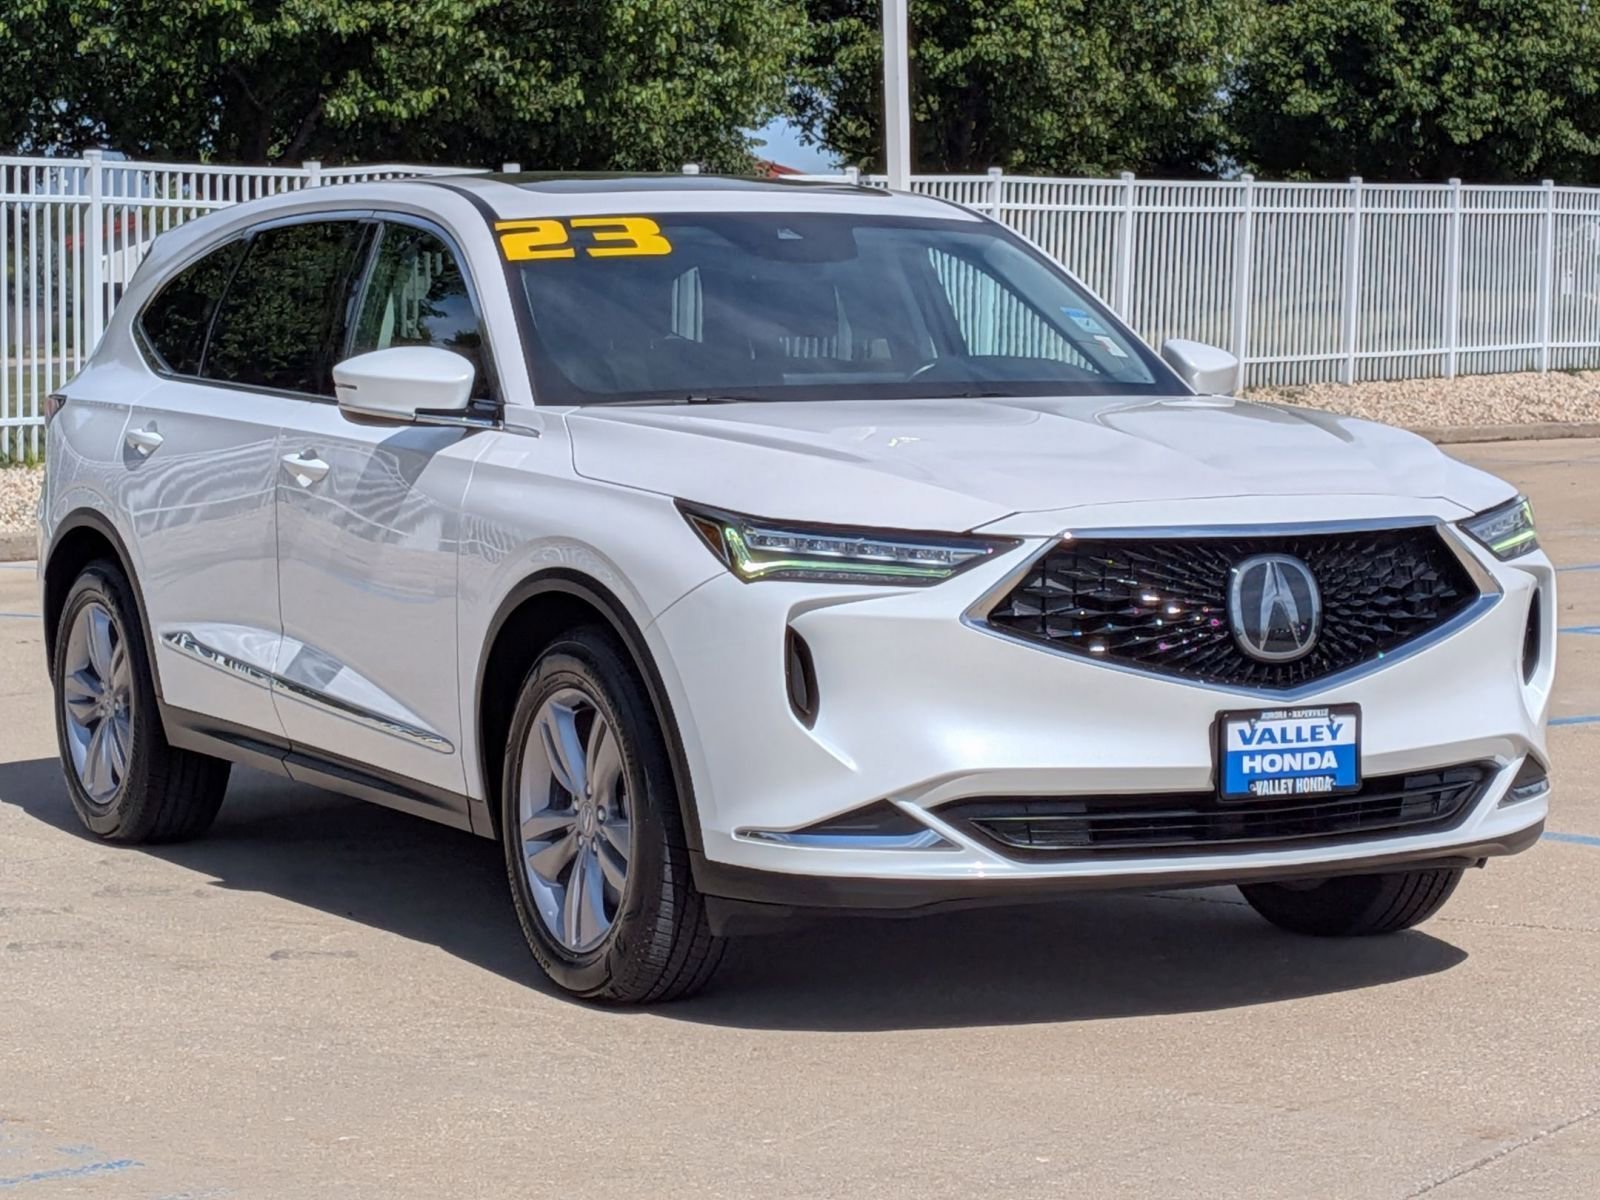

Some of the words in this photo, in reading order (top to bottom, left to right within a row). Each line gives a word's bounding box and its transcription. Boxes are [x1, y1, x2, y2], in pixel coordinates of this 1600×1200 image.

[495, 217, 672, 261] 23
[1238, 723, 1343, 746] VALLEY
[1242, 751, 1338, 774] HONDA
[1255, 778, 1294, 796] VALLEY
[1296, 776, 1332, 794] HONDA
